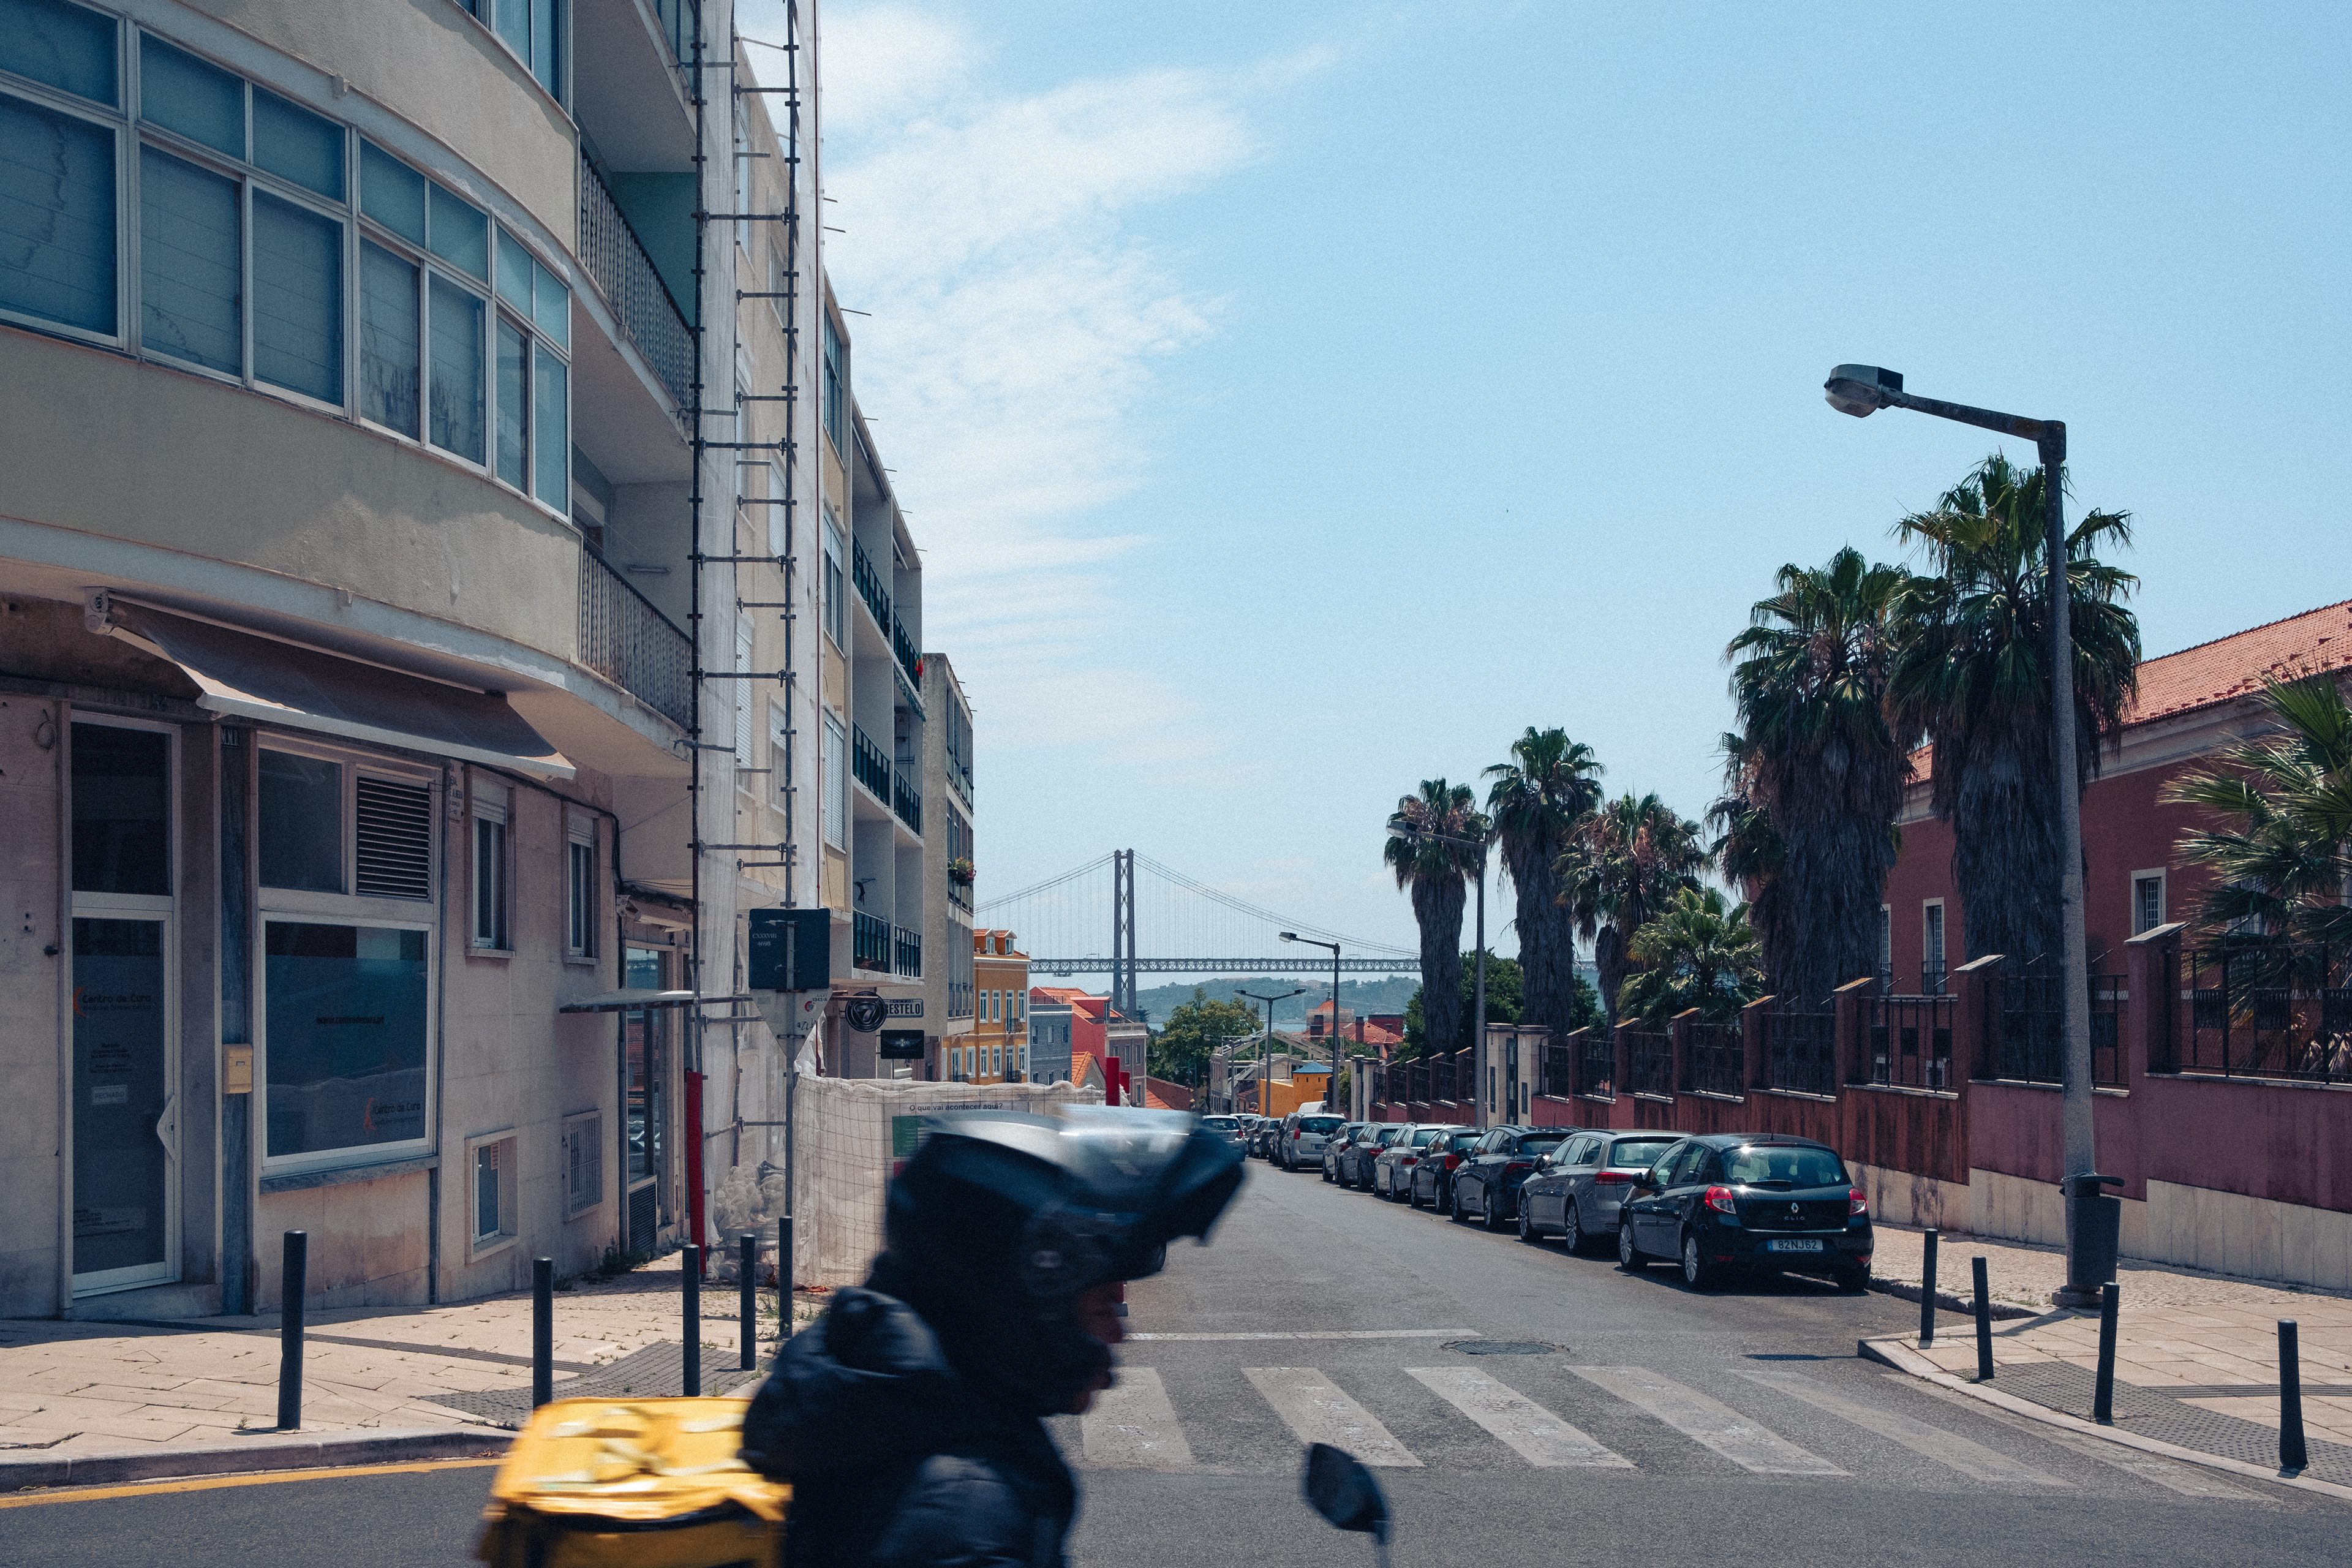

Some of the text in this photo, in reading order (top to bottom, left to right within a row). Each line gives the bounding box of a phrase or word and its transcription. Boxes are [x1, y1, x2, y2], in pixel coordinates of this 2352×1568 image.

[83, 995, 113, 1004] Centro
[131, 993, 151, 1003] Cura
[856, 1005, 875, 1021] 7
[374, 1102, 421, 1115] Centro de Cura
[1778, 1240, 1817, 1250] 82NJ62
